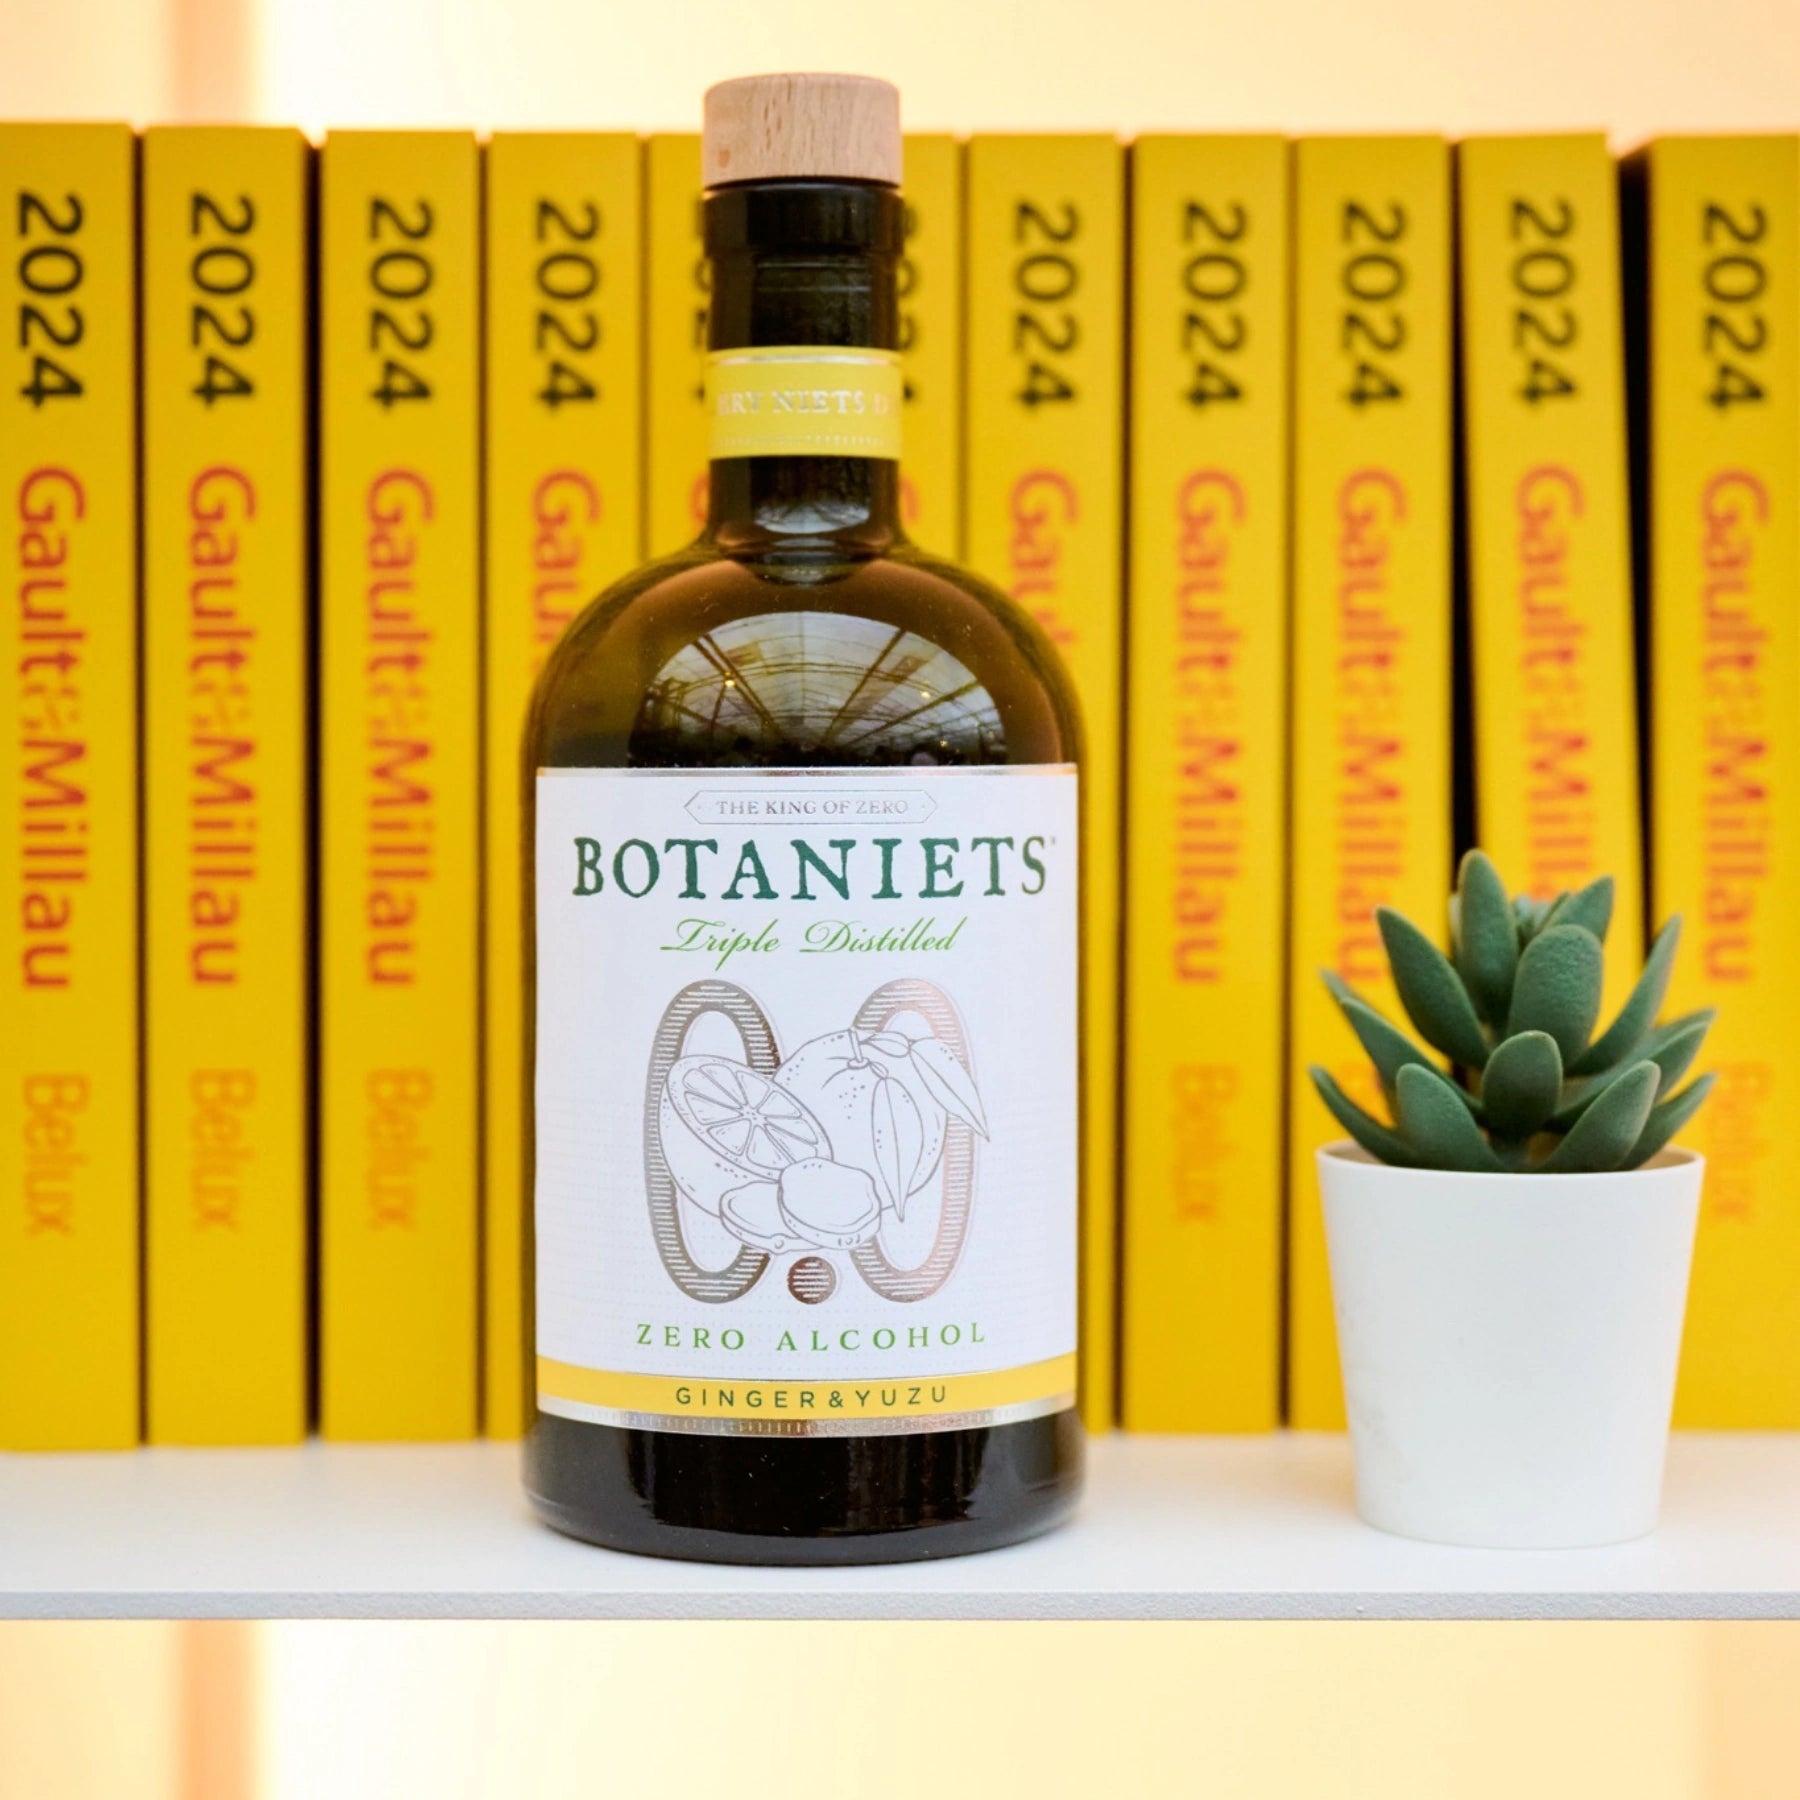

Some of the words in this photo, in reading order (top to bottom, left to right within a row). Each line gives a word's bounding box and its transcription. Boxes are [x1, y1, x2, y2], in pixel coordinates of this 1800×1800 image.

[17, 190, 85, 409] 2024
[190, 191, 256, 408] 2024
[368, 196, 435, 411] 2024
[535, 198, 600, 412] 2024
[771, 389, 865, 415] NIETS
[1014, 200, 1079, 411] 2024
[1182, 200, 1248, 410] 2024
[1341, 200, 1408, 411] 2024
[1509, 198, 1577, 408] 2024
[1702, 201, 1768, 412] 2024
[571, 835, 1047, 901] BOTANIETS
[716, 800, 760, 815] THE
[765, 800, 817, 815] KING
[822, 800, 851, 815] OF
[855, 800, 909, 815] ZERO
[659, 917, 781, 972] Triple
[798, 916, 968, 954] Distilled
[22, 1073, 90, 1237] Belux
[189, 1068, 257, 1233] Belux
[636, 1322, 746, 1351] ZERO
[775, 1321, 986, 1353] ALCOHOL
